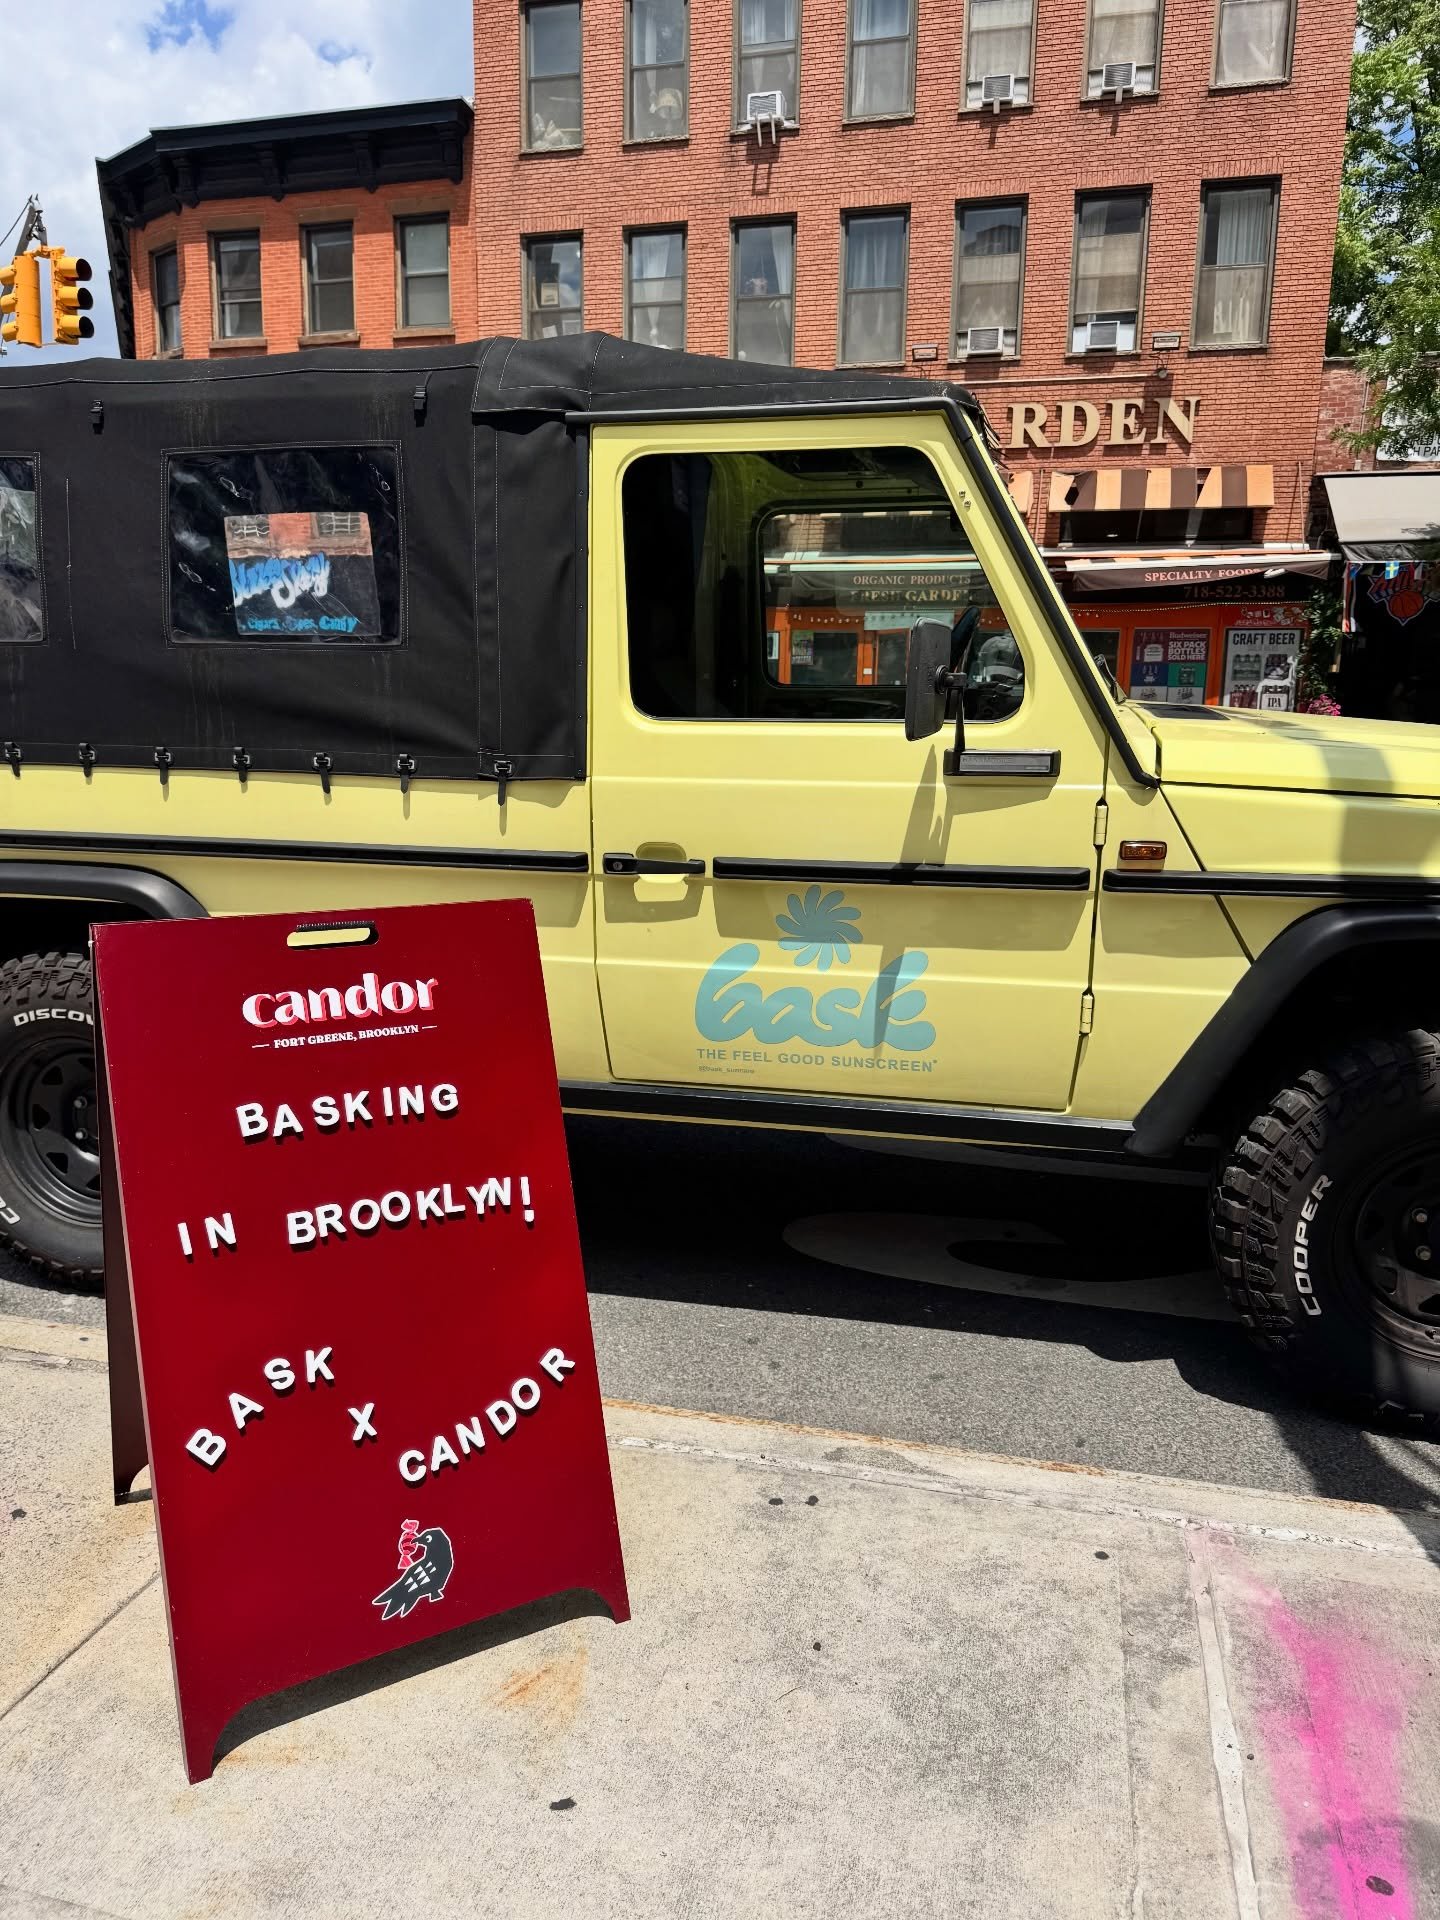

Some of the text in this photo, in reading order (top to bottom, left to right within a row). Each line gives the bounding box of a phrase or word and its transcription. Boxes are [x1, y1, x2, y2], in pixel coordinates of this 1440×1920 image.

[1006, 397, 1200, 448] RDEN
[853, 575, 971, 585] ORGANIC PRODUCTS
[1145, 570, 1212, 582] SPECIALTY
[1184, 585, 1285, 598] 718-522-3388
[1168, 641, 1206, 649] SIX PACK
[1233, 633, 1295, 645] CRAFT BEER
[242, 973, 438, 1028] candor
[695, 942, 936, 1051] bask
[274, 1025, 419, 1048] FORT GREENE, BROOKLYN
[697, 1049, 727, 1060] THE
[733, 1050, 772, 1063] FEEL
[778, 1053, 825, 1066] GOOD
[235, 1083, 459, 1138] BASKING
[178, 1176, 534, 1255] IN BROOKLYN!
[1293, 1174, 1333, 1316] COOPER
[185, 1346, 335, 1466] BASK
[398, 1347, 576, 1482] CANDOR
